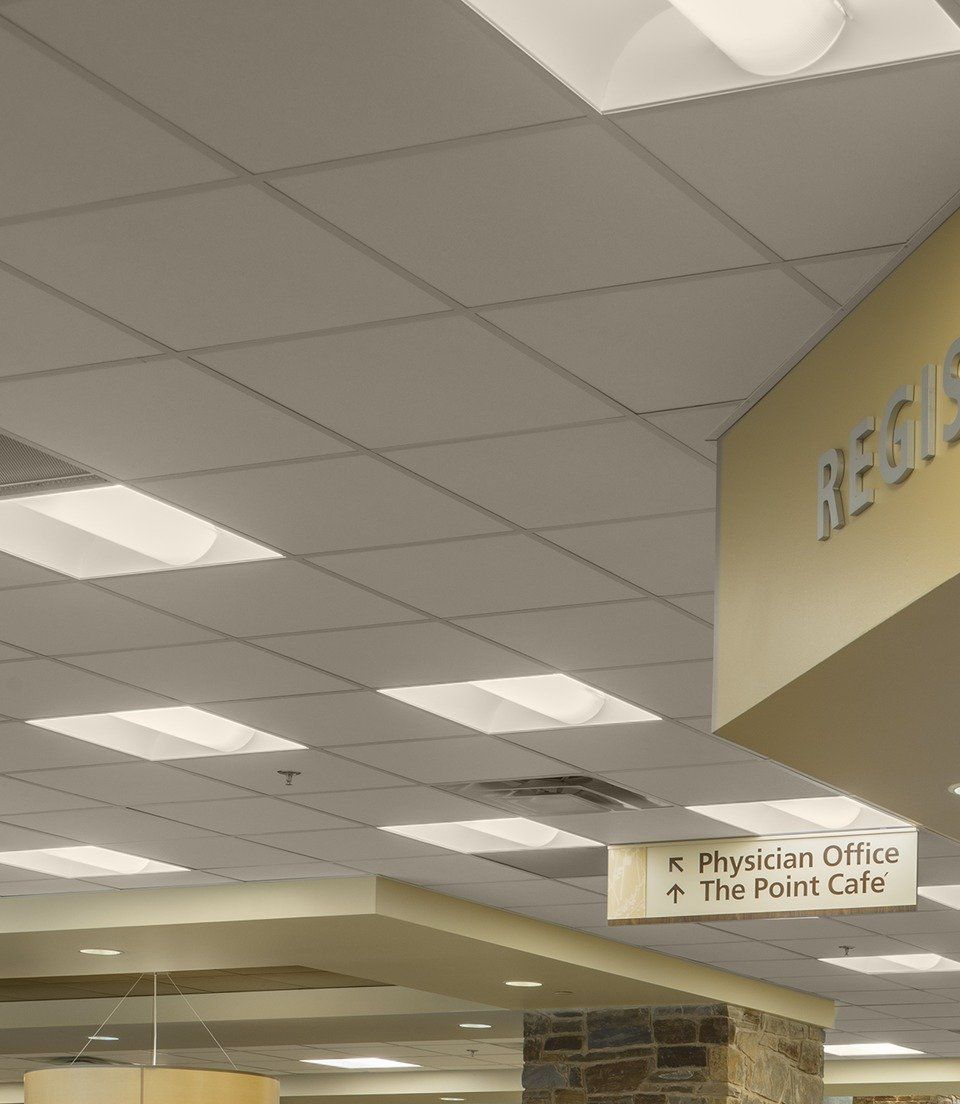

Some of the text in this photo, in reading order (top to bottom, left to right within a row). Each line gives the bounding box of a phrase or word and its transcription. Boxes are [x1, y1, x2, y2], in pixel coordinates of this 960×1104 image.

[699, 842, 900, 878] Physician Office
[699, 879, 746, 901] The
[754, 874, 820, 899] Point
